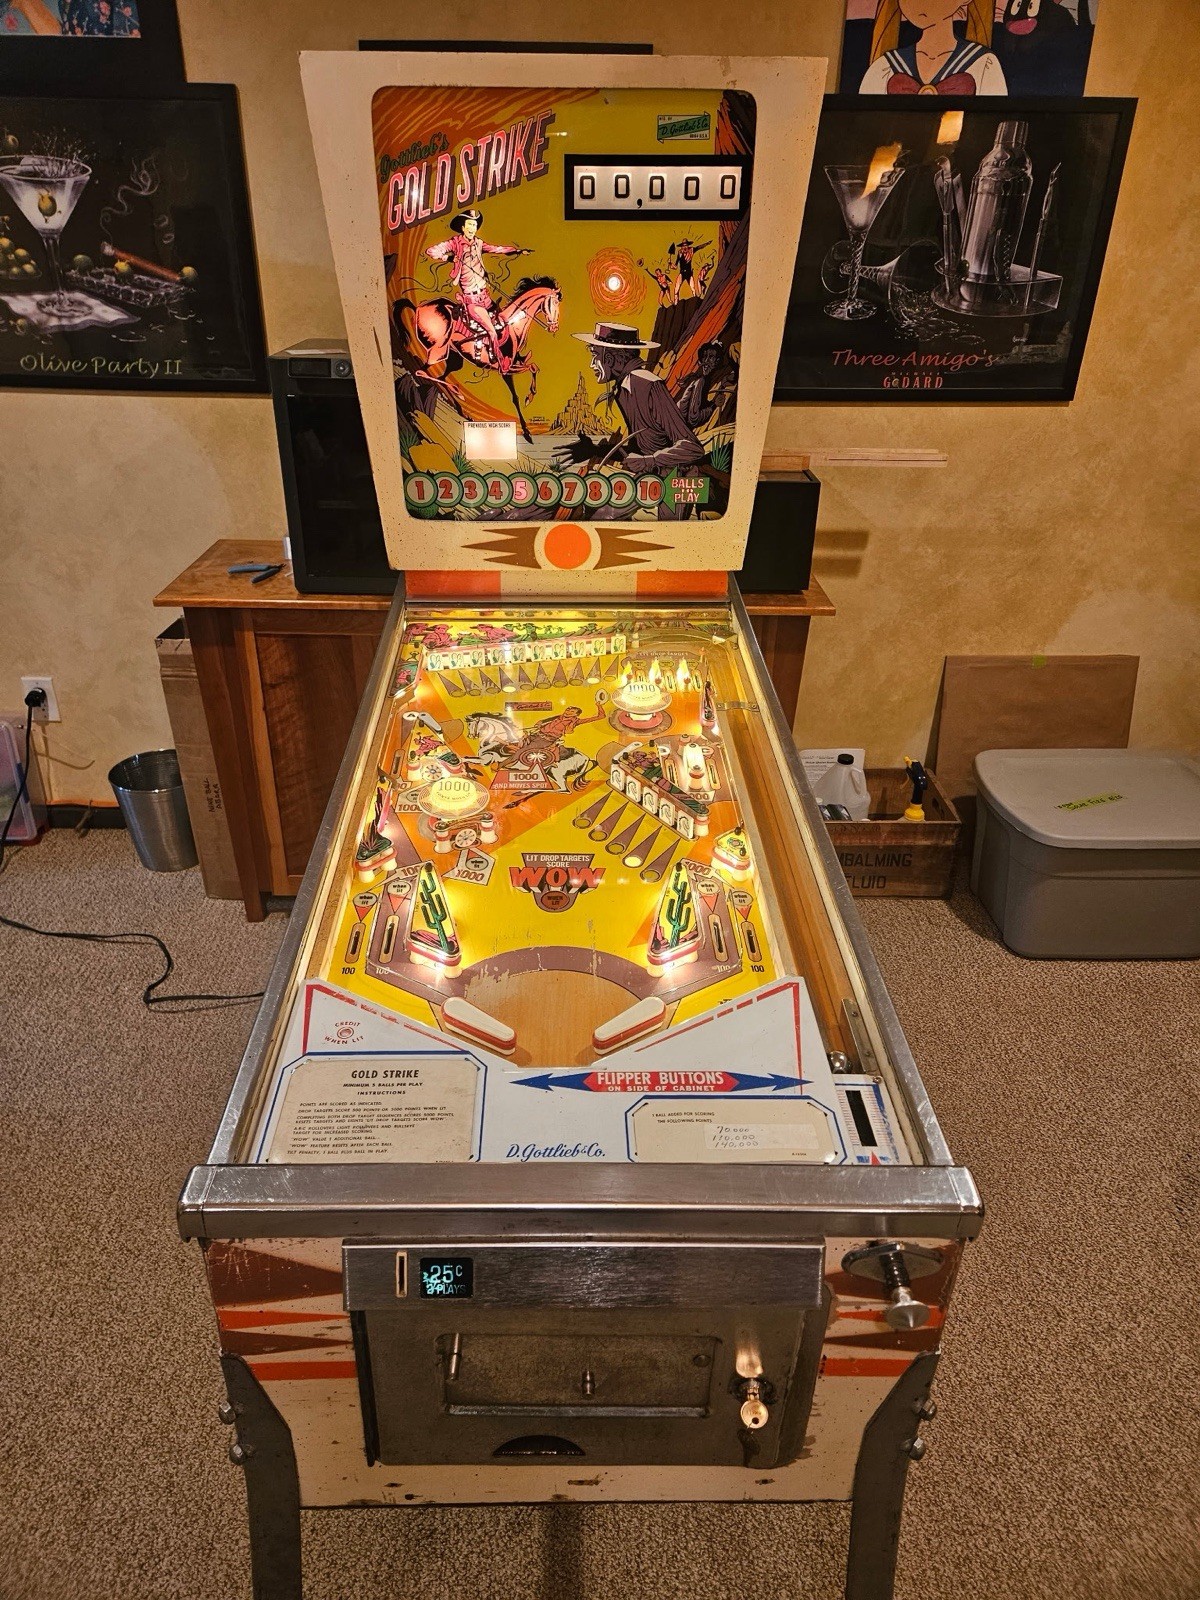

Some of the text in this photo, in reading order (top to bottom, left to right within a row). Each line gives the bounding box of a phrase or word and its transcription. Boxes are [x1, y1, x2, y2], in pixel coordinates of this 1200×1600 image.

[379, 131, 450, 184] Gottlieb's
[387, 110, 555, 233] GOLD STRIKE
[20, 352, 183, 379] Olive Party II
[832, 349, 1000, 372] Three Amigo's
[883, 376, 944, 389] GODARD
[671, 478, 704, 488] BALLS
[415, 479, 662, 502] 1 2 3 4 5 6 7 8 9 10
[674, 493, 700, 502] PLAY
[438, 780, 470, 792] 1000
[456, 870, 485, 882] 1000
[509, 867, 606, 891] WOW
[341, 966, 356, 974] 100
[324, 1036, 348, 1044] WHEN
[352, 1070, 420, 1078] GOLD STRIKE
[597, 1072, 724, 1085] FLIPPER BUTTONS
